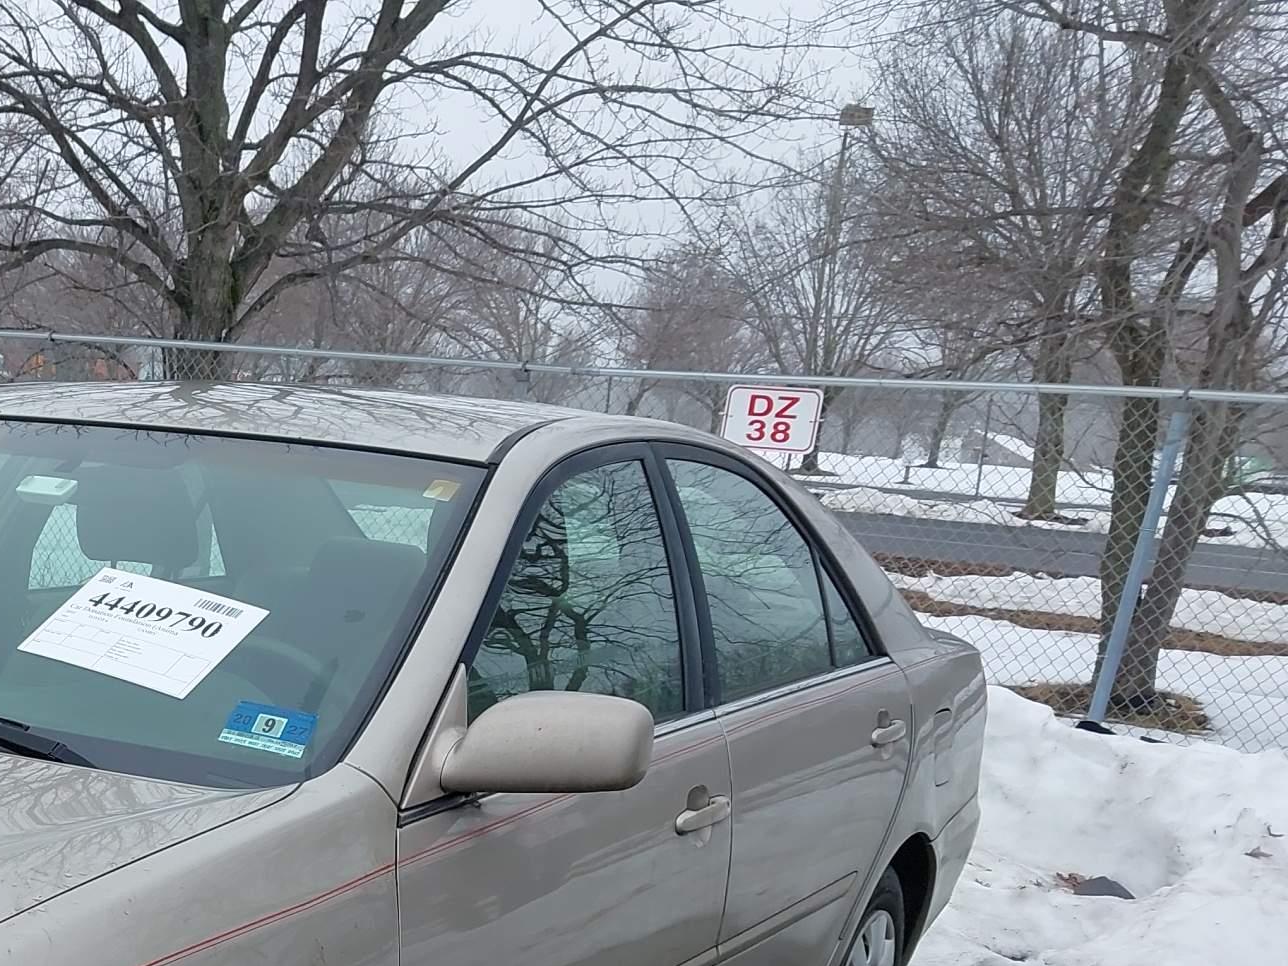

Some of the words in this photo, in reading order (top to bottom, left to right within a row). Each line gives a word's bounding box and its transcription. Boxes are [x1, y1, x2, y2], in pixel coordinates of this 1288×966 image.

[748, 394, 801, 419] DZ
[746, 419, 791, 443] 38
[88, 592, 223, 638] 44409790
[262, 718, 276, 733] 9
